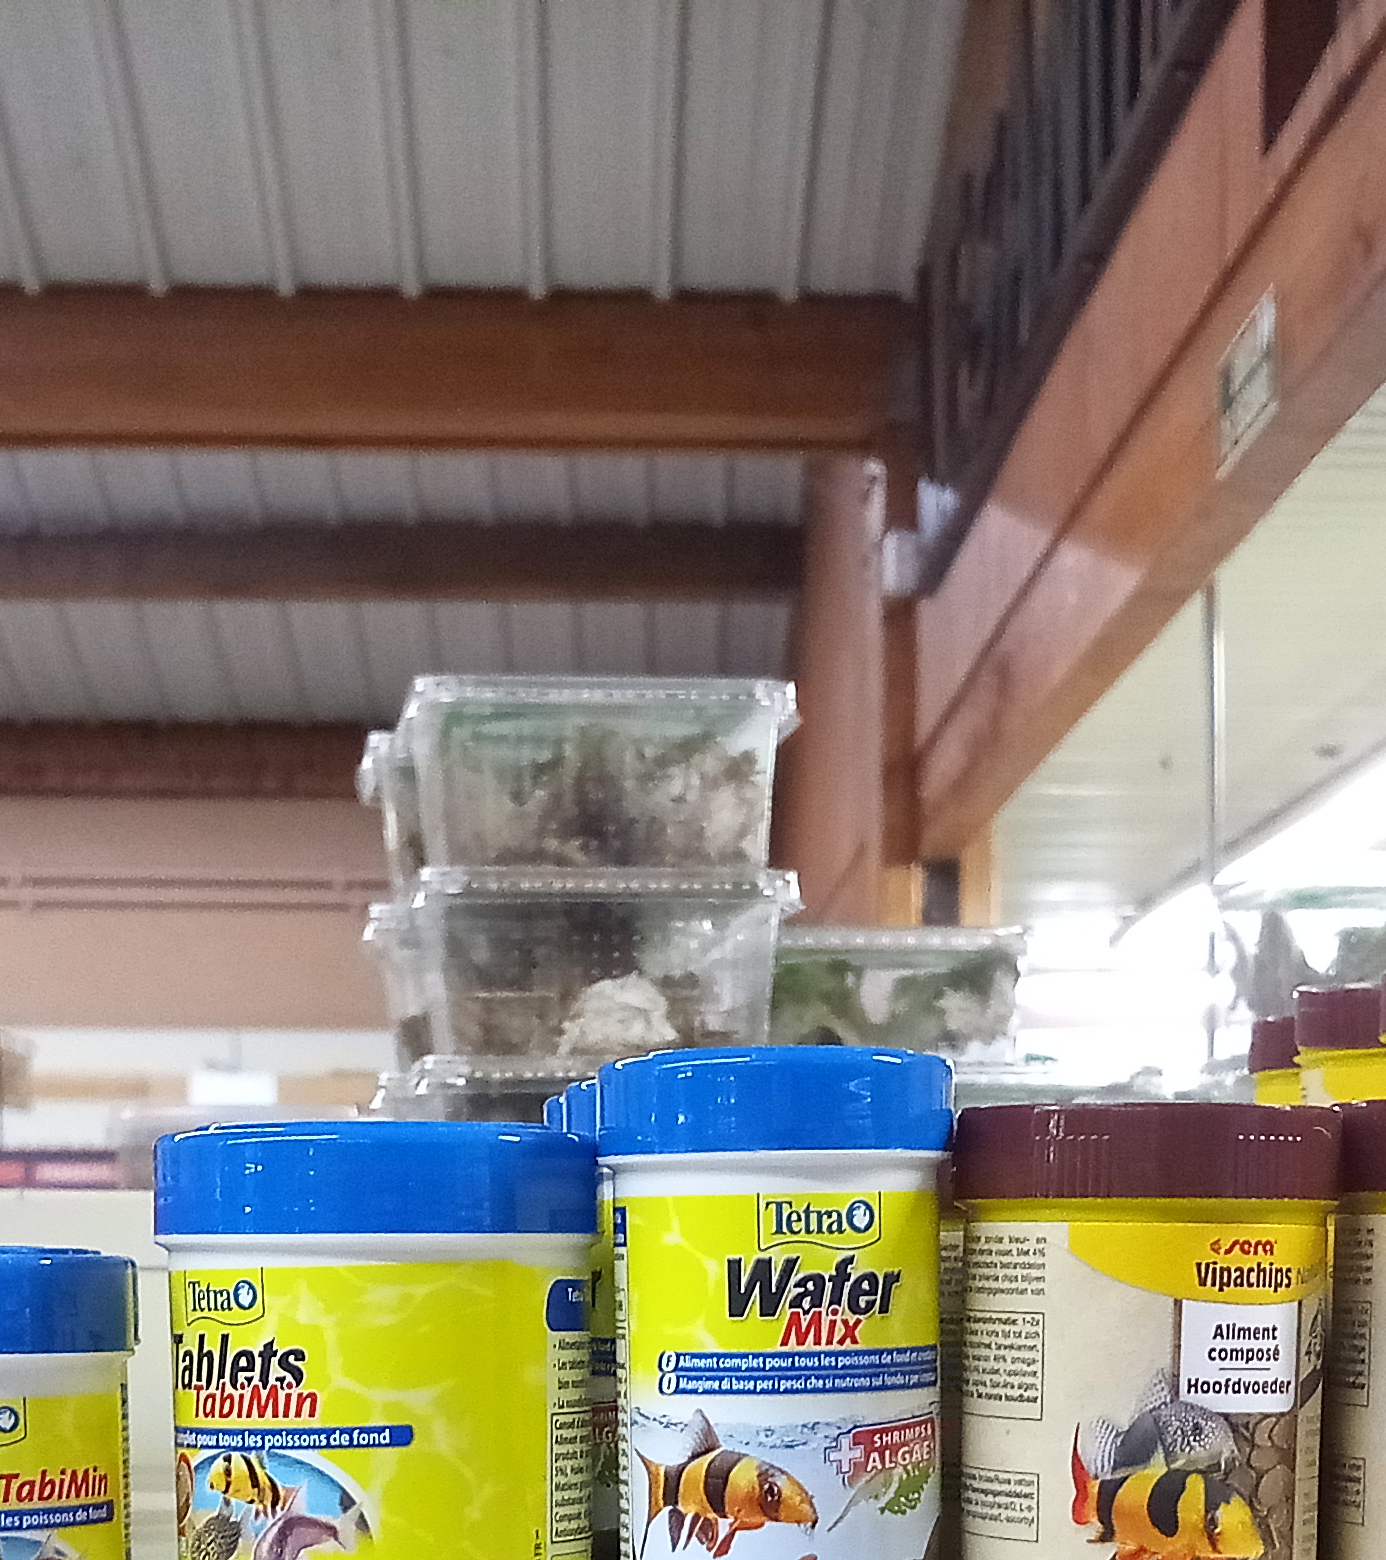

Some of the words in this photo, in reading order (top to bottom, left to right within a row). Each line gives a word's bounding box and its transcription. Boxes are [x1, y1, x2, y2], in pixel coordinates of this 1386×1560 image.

[765, 1200, 846, 1236] Tetra
[1224, 1239, 1275, 1256] sera
[725, 1254, 902, 1319] Wafer
[1195, 1261, 1293, 1292] Vipachips
[188, 1279, 233, 1312] Tetra
[779, 1308, 863, 1347] Mix
[1213, 1324, 1279, 1341] Aliment
[173, 1333, 306, 1391] Tablets
[678, 1355, 718, 1368] Aliment
[720, 1356, 763, 1370] complet
[765, 1357, 792, 1370] pour
[794, 1355, 820, 1368] tous
[821, 1354, 836, 1367] les
[838, 1352, 880, 1367] poissons
[881, 1352, 891, 1364] de
[1208, 1341, 1280, 1364] composé
[193, 1381, 319, 1420] TabiMin
[1186, 1376, 1292, 1395] Hoofdvoeder
[219, 1431, 243, 1447] tous
[244, 1431, 262, 1447] les
[265, 1429, 327, 1449] poissons
[330, 1429, 350, 1446] de
[353, 1428, 391, 1445] fond
[866, 1441, 932, 1472] ALGAE
[0, 1466, 109, 1503] TabiMin
[1, 1514, 20, 1528] les
[22, 1511, 74, 1529] poissons
